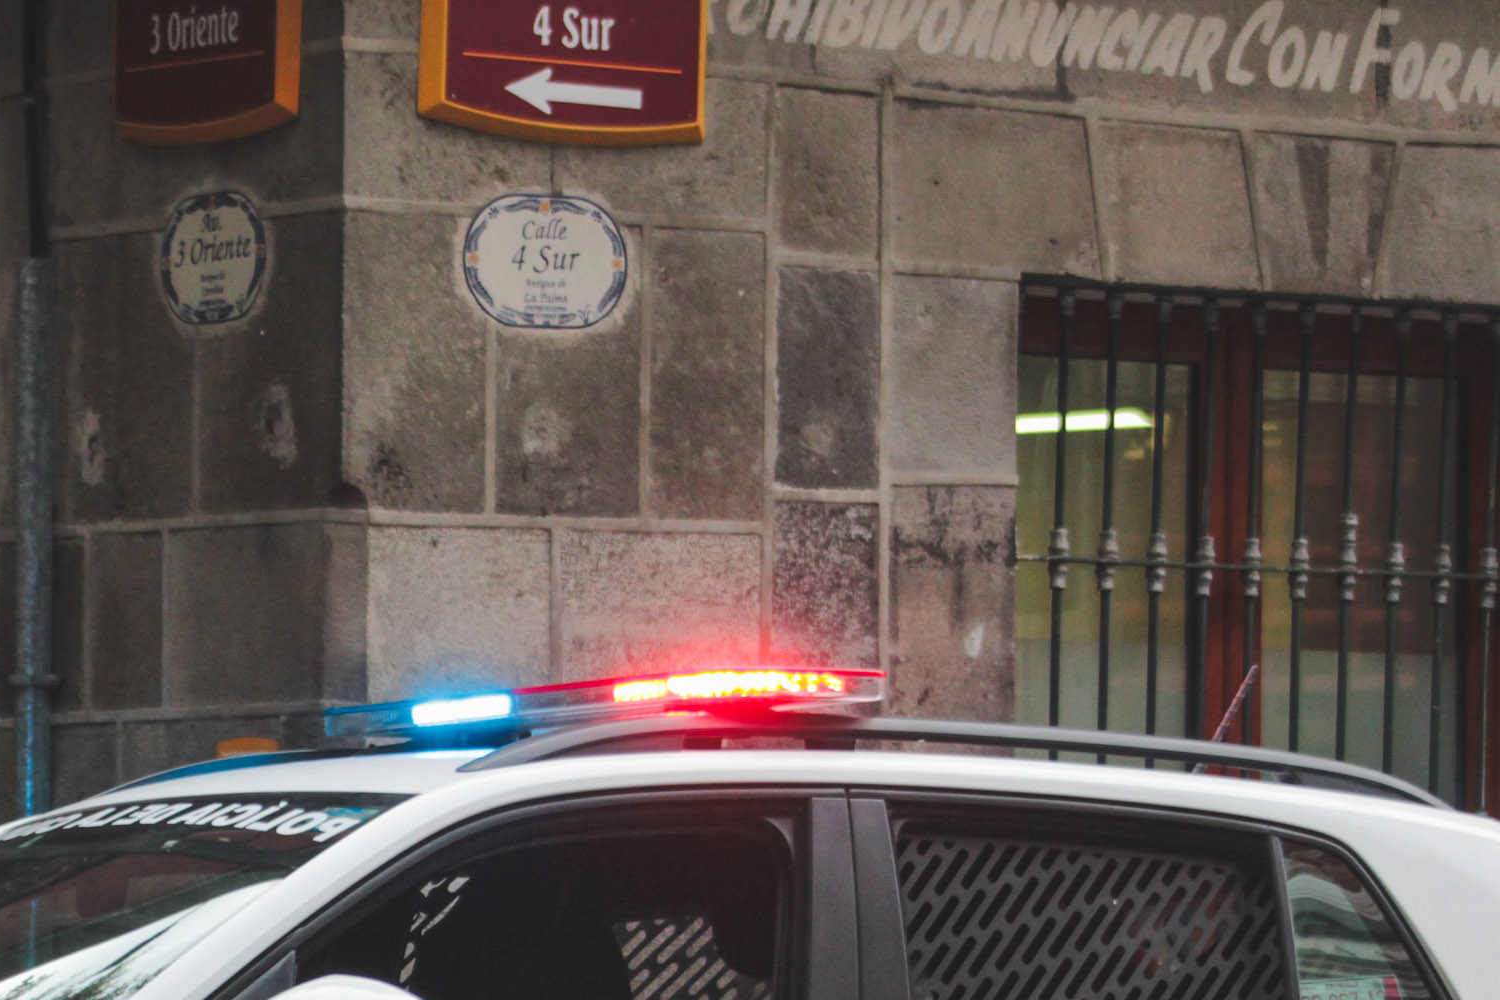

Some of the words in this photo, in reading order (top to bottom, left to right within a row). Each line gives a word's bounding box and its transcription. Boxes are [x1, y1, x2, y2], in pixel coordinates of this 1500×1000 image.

[149, 14, 161, 54] 3
[167, 5, 239, 52] Oriente
[533, 5, 552, 46] 4
[561, 7, 615, 51] Sur
[522, 218, 567, 240] Calle
[174, 240, 187, 268] 3
[190, 235, 251, 265] Oriente
[511, 245, 526, 271] 4
[533, 245, 580, 273] Sur
